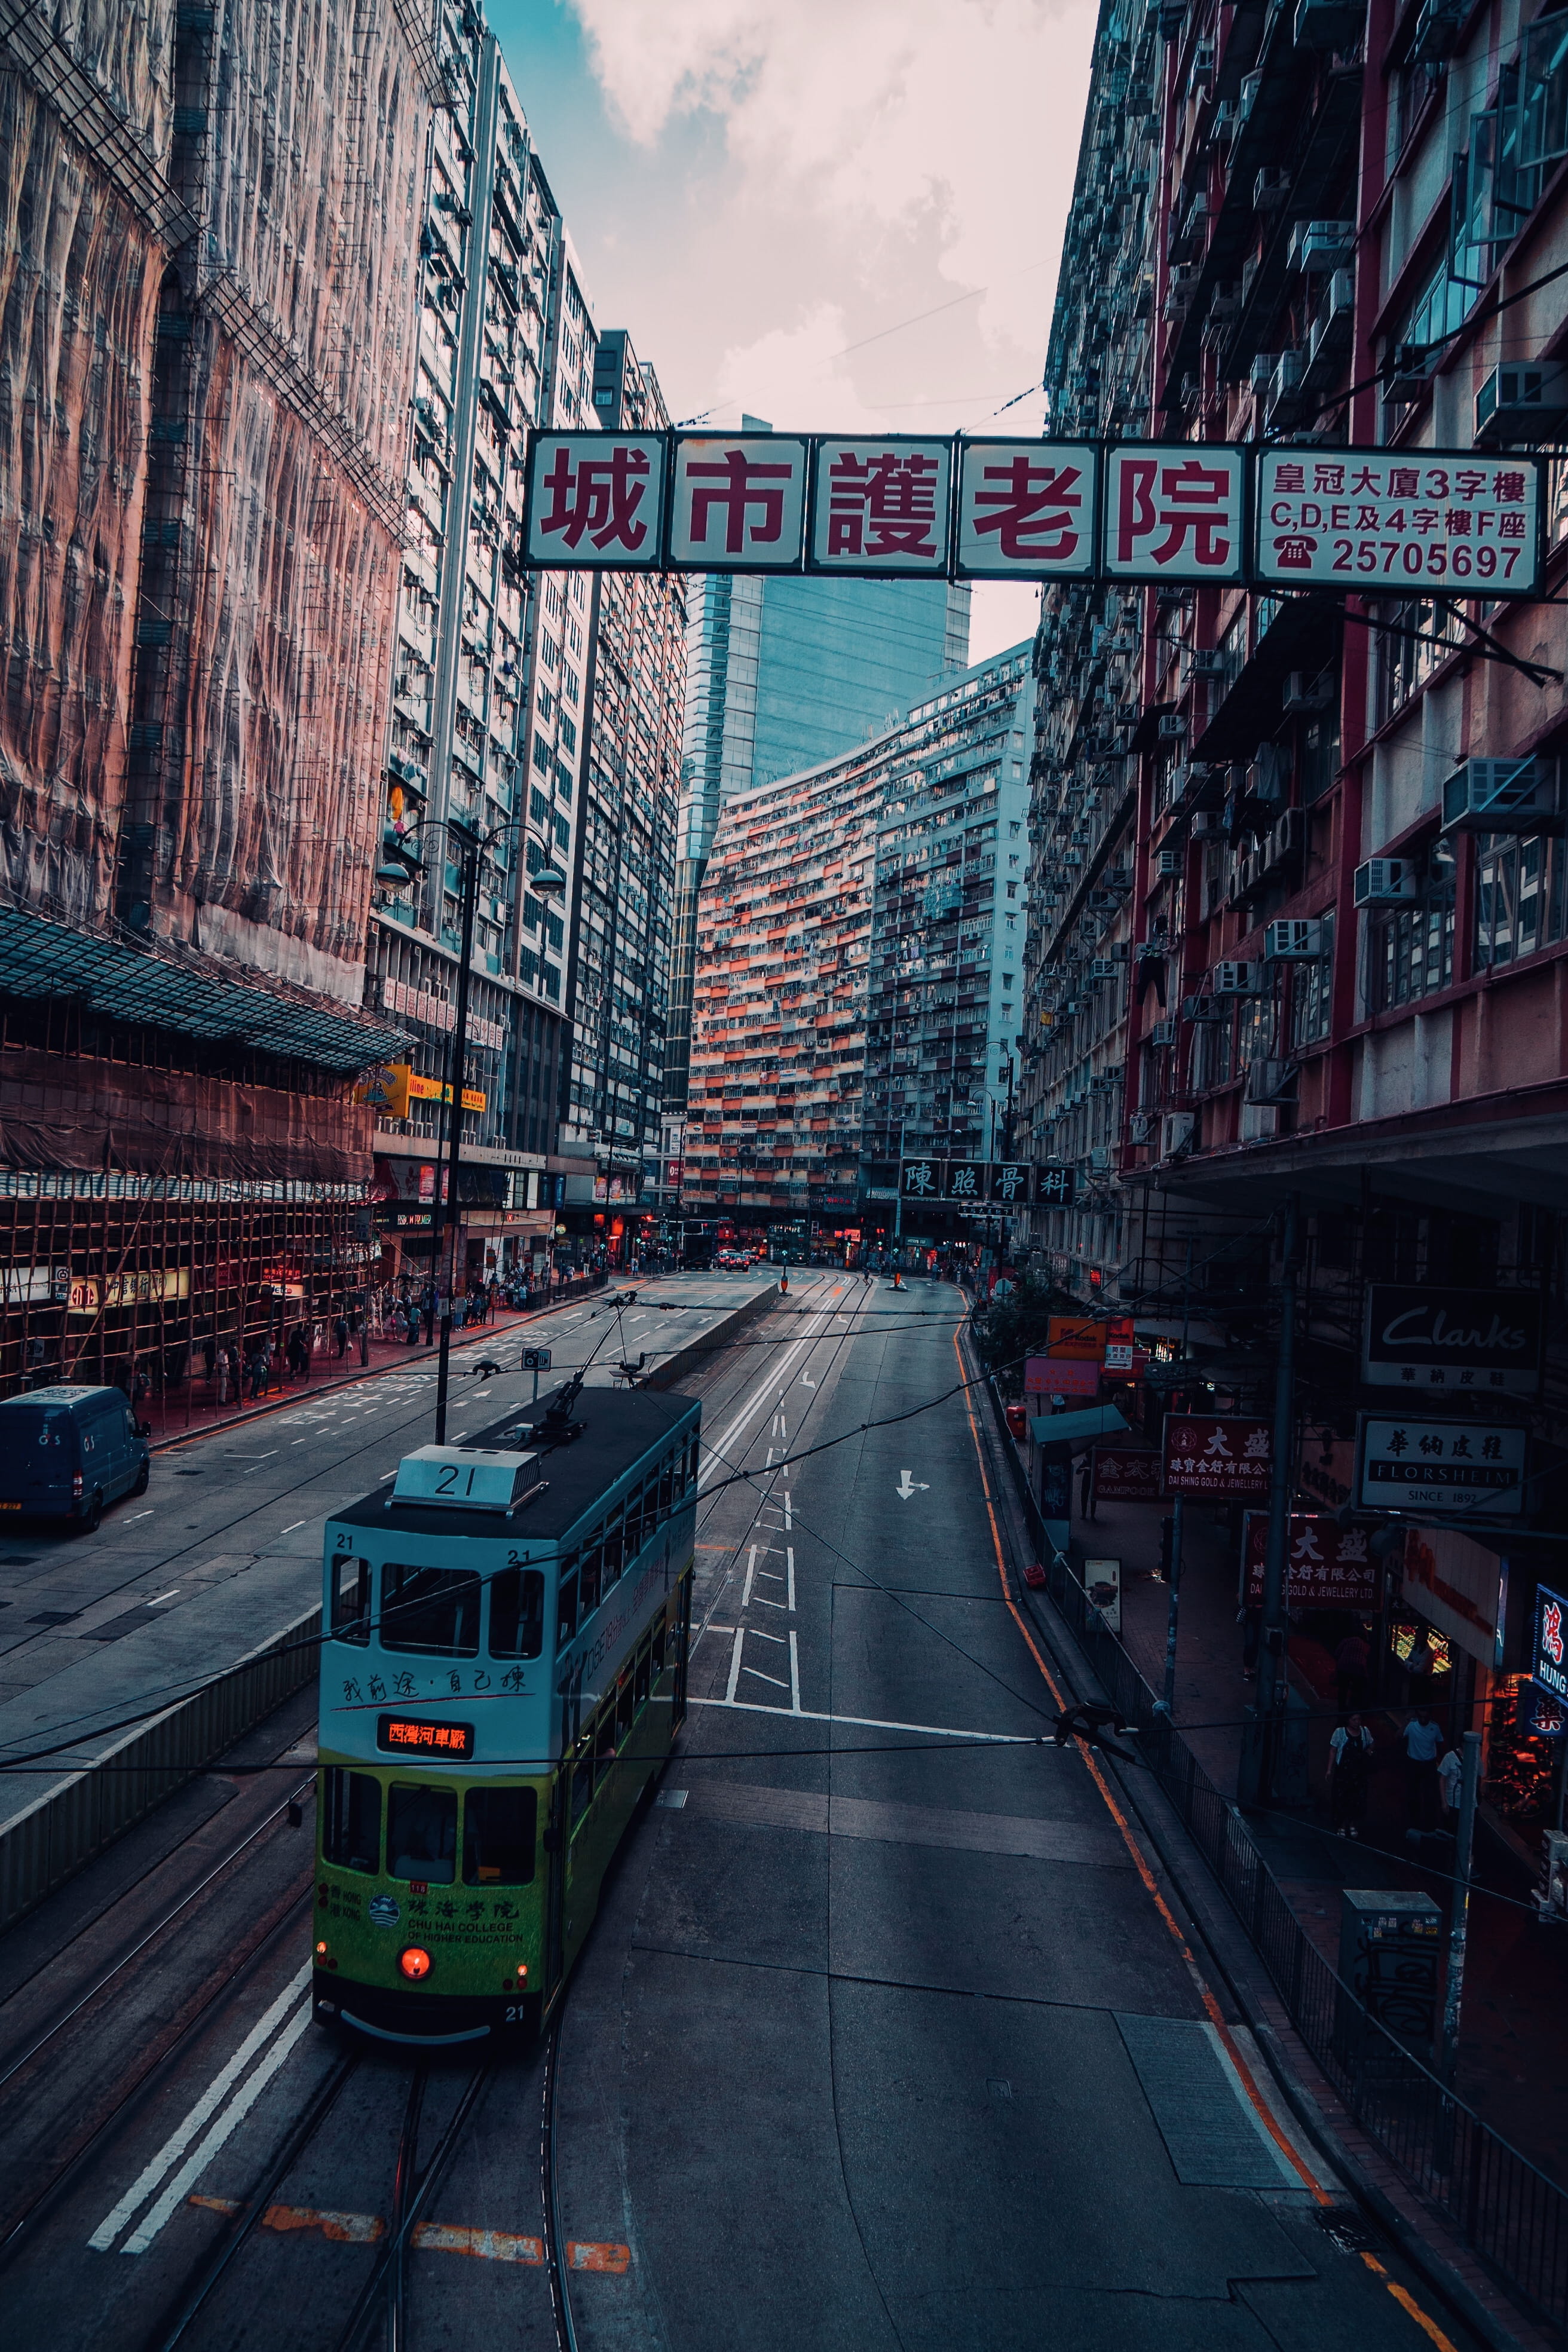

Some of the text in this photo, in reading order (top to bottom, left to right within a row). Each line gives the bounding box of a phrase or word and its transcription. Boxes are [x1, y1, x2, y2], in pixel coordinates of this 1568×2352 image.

[1273, 463, 1526, 504] 皇冠大廈3字樓
[540, 447, 1231, 566] 城市護老院
[1270, 502, 1527, 540] C,D,E及4字樓F座
[1331, 538, 1523, 579] 25705697
[905, 1162, 1070, 1203] 陳照骨科
[1382, 1305, 1526, 1350] Clarks
[346, 1382, 424, 1392] STOP
[1401, 1367, 1505, 1387] 華納皮鞋
[1203, 1426, 1271, 1459] 大盛
[1386, 1429, 1503, 1460] 華納皮鞋
[434, 1465, 476, 1497] 21
[1168, 1475, 1180, 1486] DAI
[1181, 1476, 1200, 1487] SHING
[1200, 1477, 1218, 1487] GOLD
[1219, 1478, 1226, 1487] &
[1227, 1478, 1263, 1490] JEWELLERY
[1377, 1464, 1512, 1484] FLORSHEIM
[1408, 1490, 1477, 1503] SINCE 1892
[337, 1533, 353, 1550] 21
[1290, 1526, 1368, 1563] 大盛
[507, 1549, 531, 1566] 21
[1252, 1563, 1375, 1583] 珠金行有限公司
[1250, 1583, 1263, 1594] DAI
[1288, 1585, 1307, 1597] GOLD
[1309, 1587, 1315, 1597] &
[1317, 1587, 1359, 1598] JEWELLERY
[1360, 1588, 1374, 1599] LTD.
[1539, 1659, 1567, 1694] HUNG
[388, 1722, 466, 1750] 西灣河車廠
[343, 1891, 362, 1905] HONG
[411, 1884, 426, 1894] 118
[342, 1906, 360, 1921] KONG
[408, 1919, 514, 1933] CHU HAI COLLEGE
[408, 1931, 523, 1943] OF HIGHER EDUCATION
[506, 2004, 524, 2022] 21
